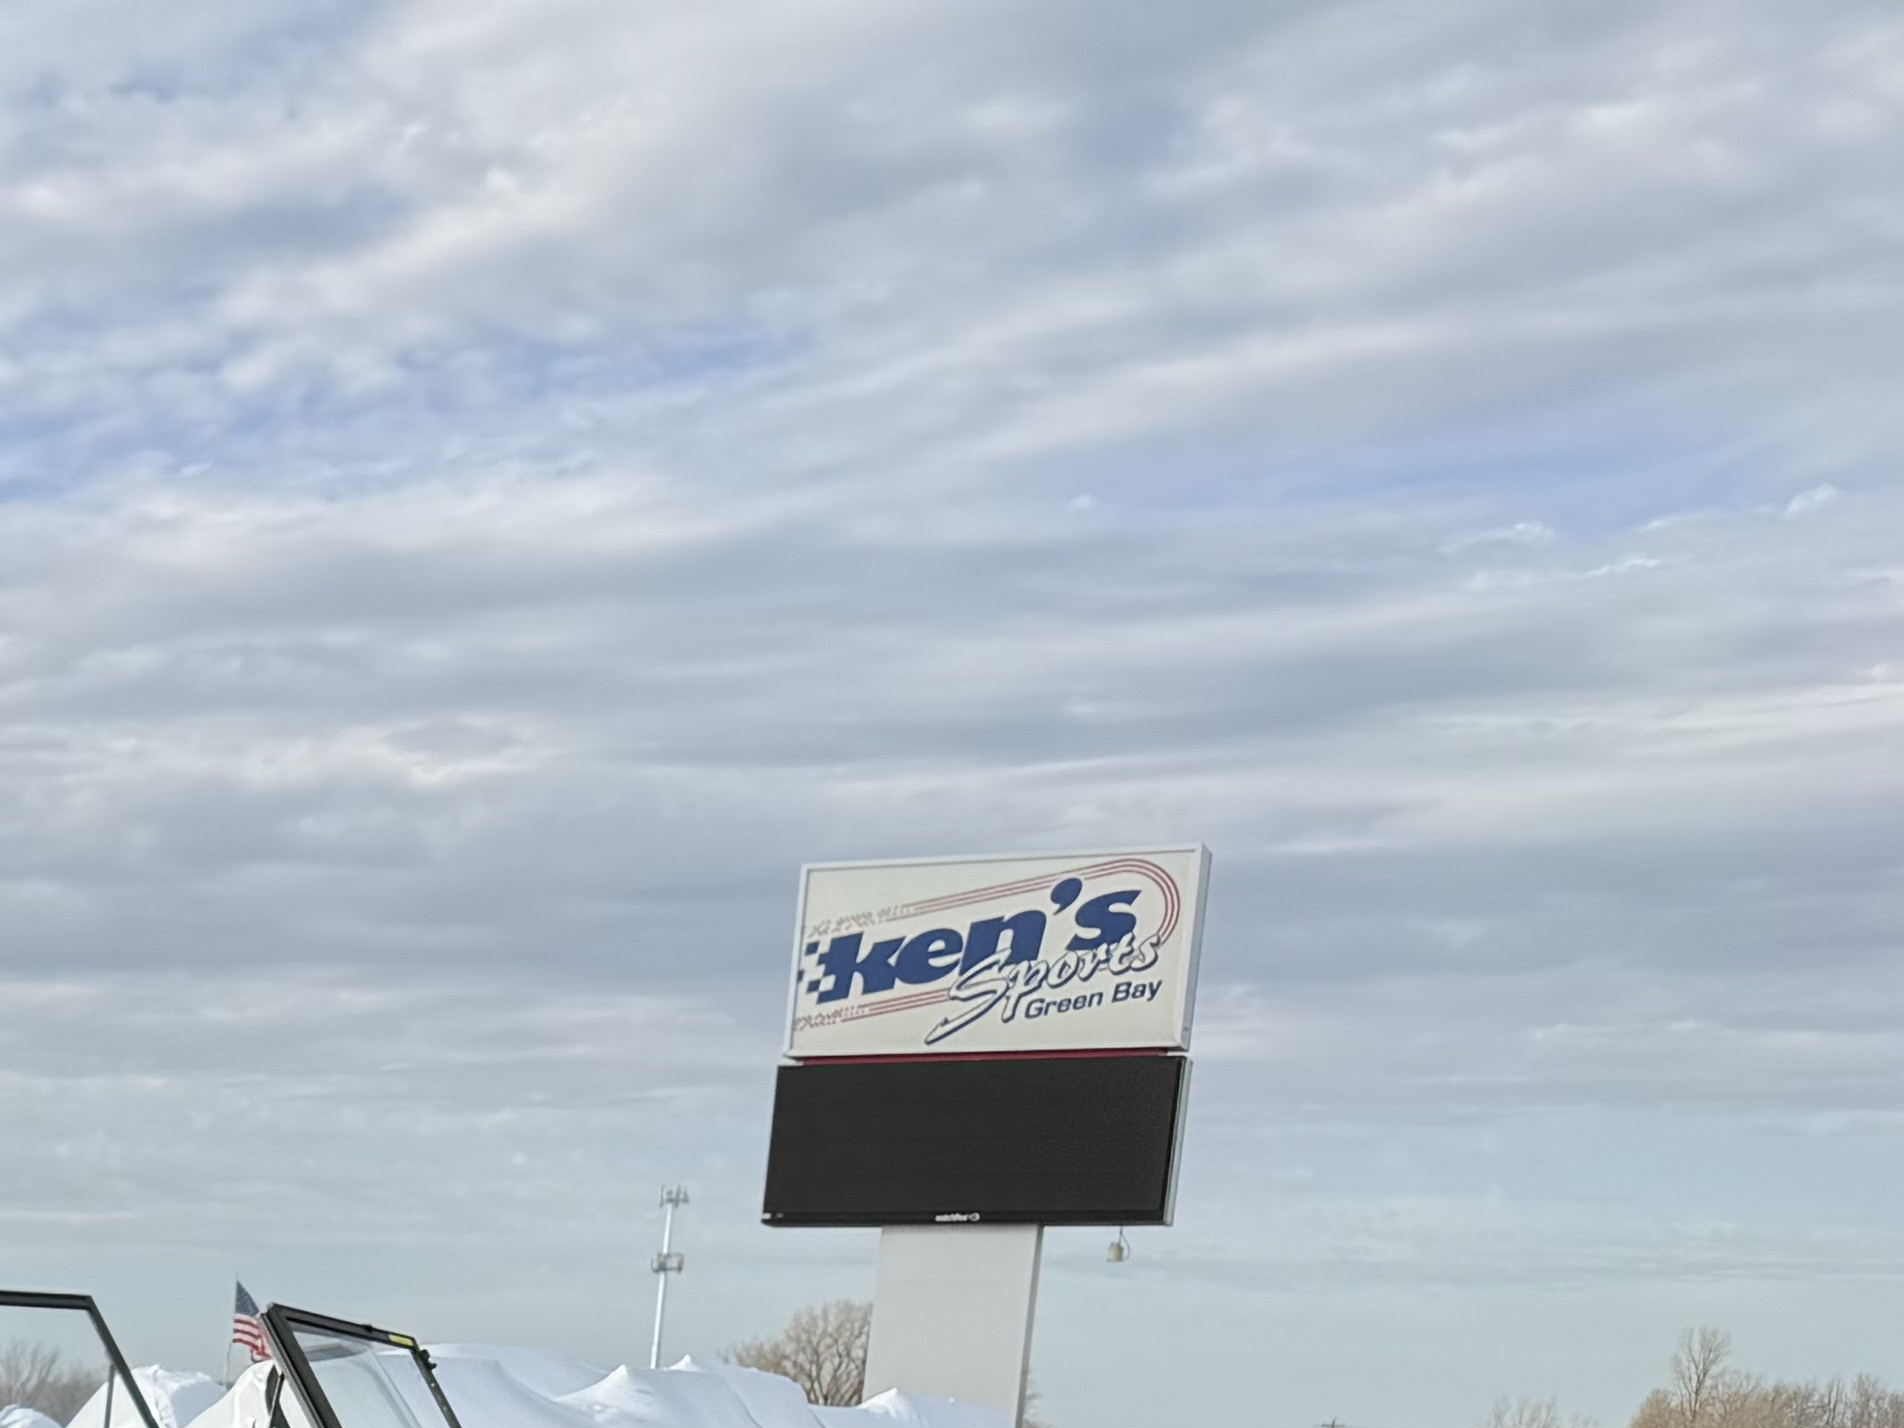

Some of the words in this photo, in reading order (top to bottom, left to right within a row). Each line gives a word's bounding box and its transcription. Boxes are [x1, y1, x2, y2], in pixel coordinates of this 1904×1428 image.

[924, 931, 1162, 1045] Sports
[1024, 991, 1104, 1020] Green
[1111, 979, 1163, 1004] Bay
